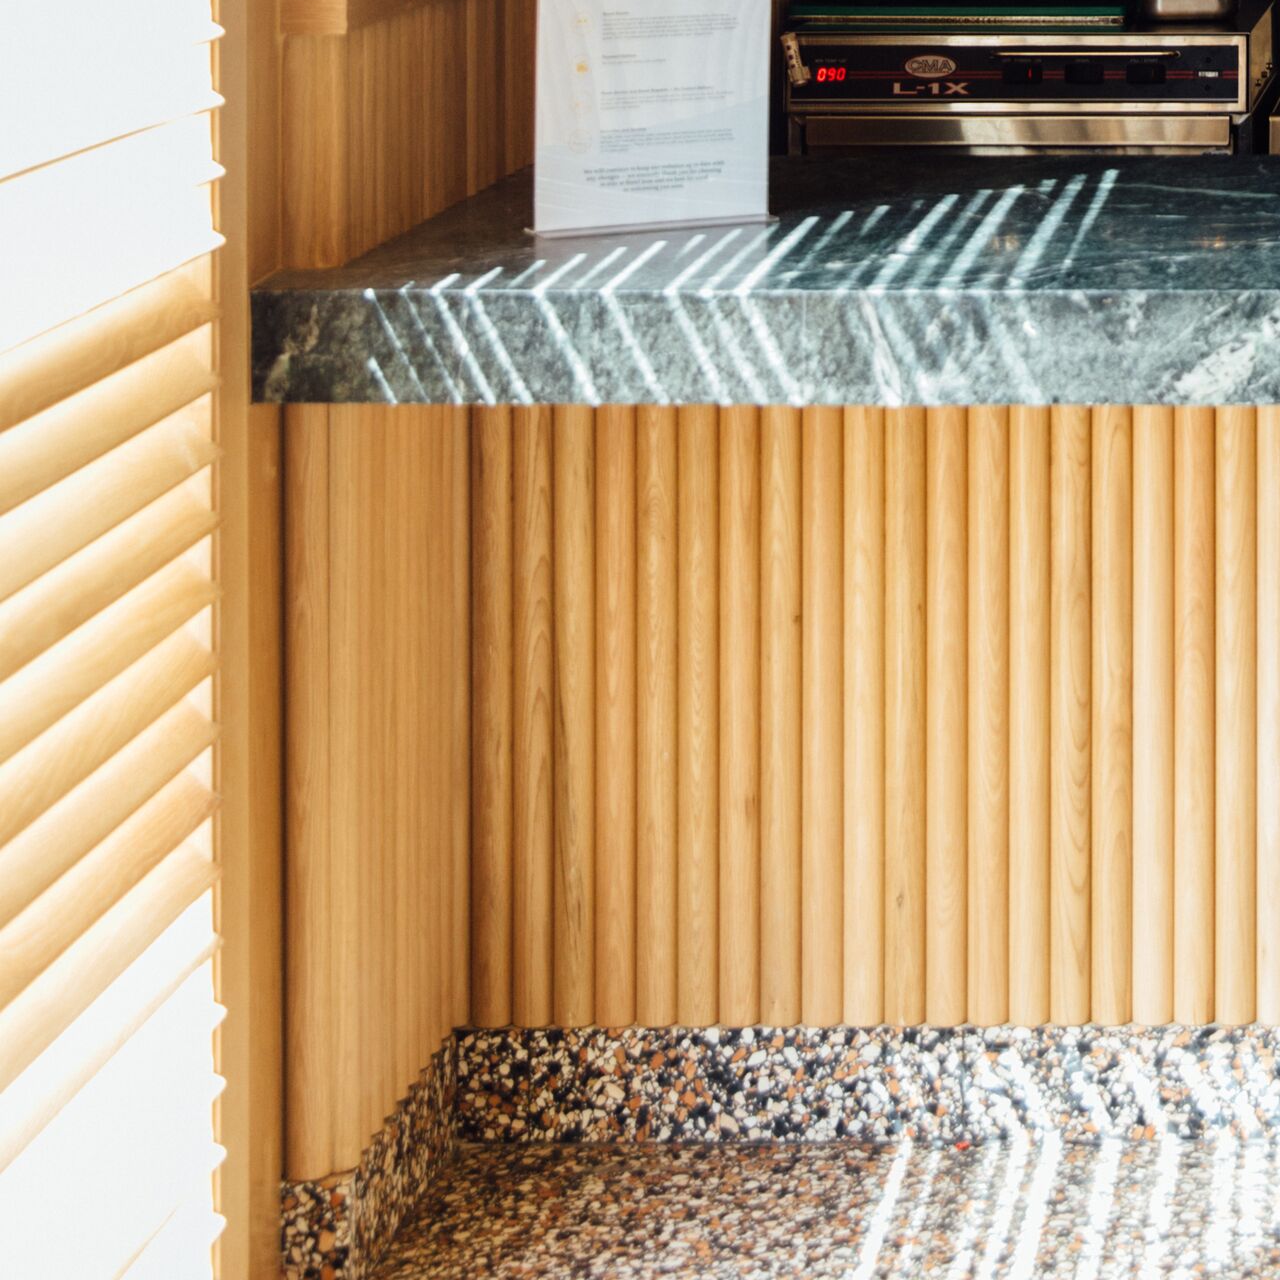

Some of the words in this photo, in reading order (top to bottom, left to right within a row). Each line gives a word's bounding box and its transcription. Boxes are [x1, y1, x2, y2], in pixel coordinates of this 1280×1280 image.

[911, 59, 953, 74] CMA
[816, 67, 847, 83] 090
[893, 82, 969, 95] L-1X
